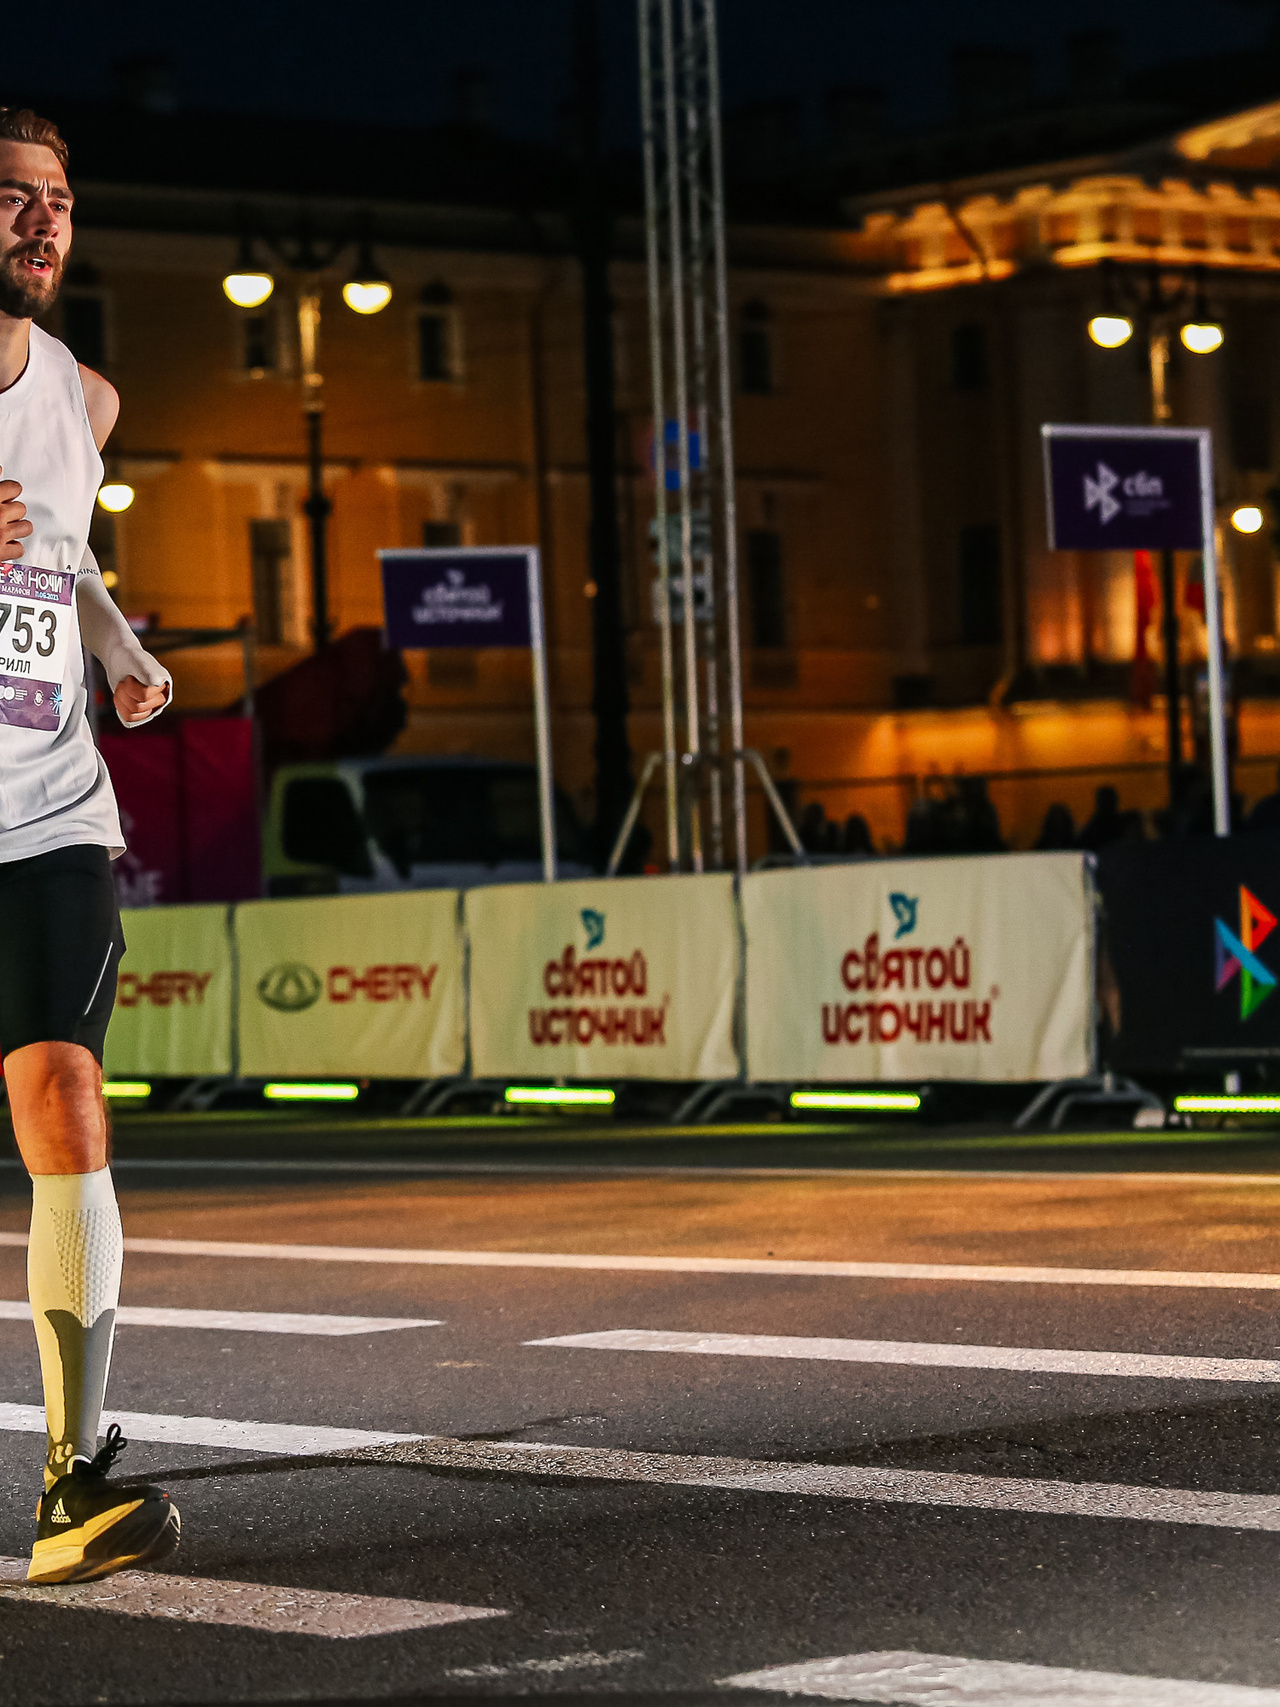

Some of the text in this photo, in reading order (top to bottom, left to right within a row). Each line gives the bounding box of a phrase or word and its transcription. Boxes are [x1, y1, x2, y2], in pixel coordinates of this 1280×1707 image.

[28, 570, 63, 594] НОЧИ
[117, 971, 213, 1008] CHERY
[327, 962, 439, 1004] CHERY
